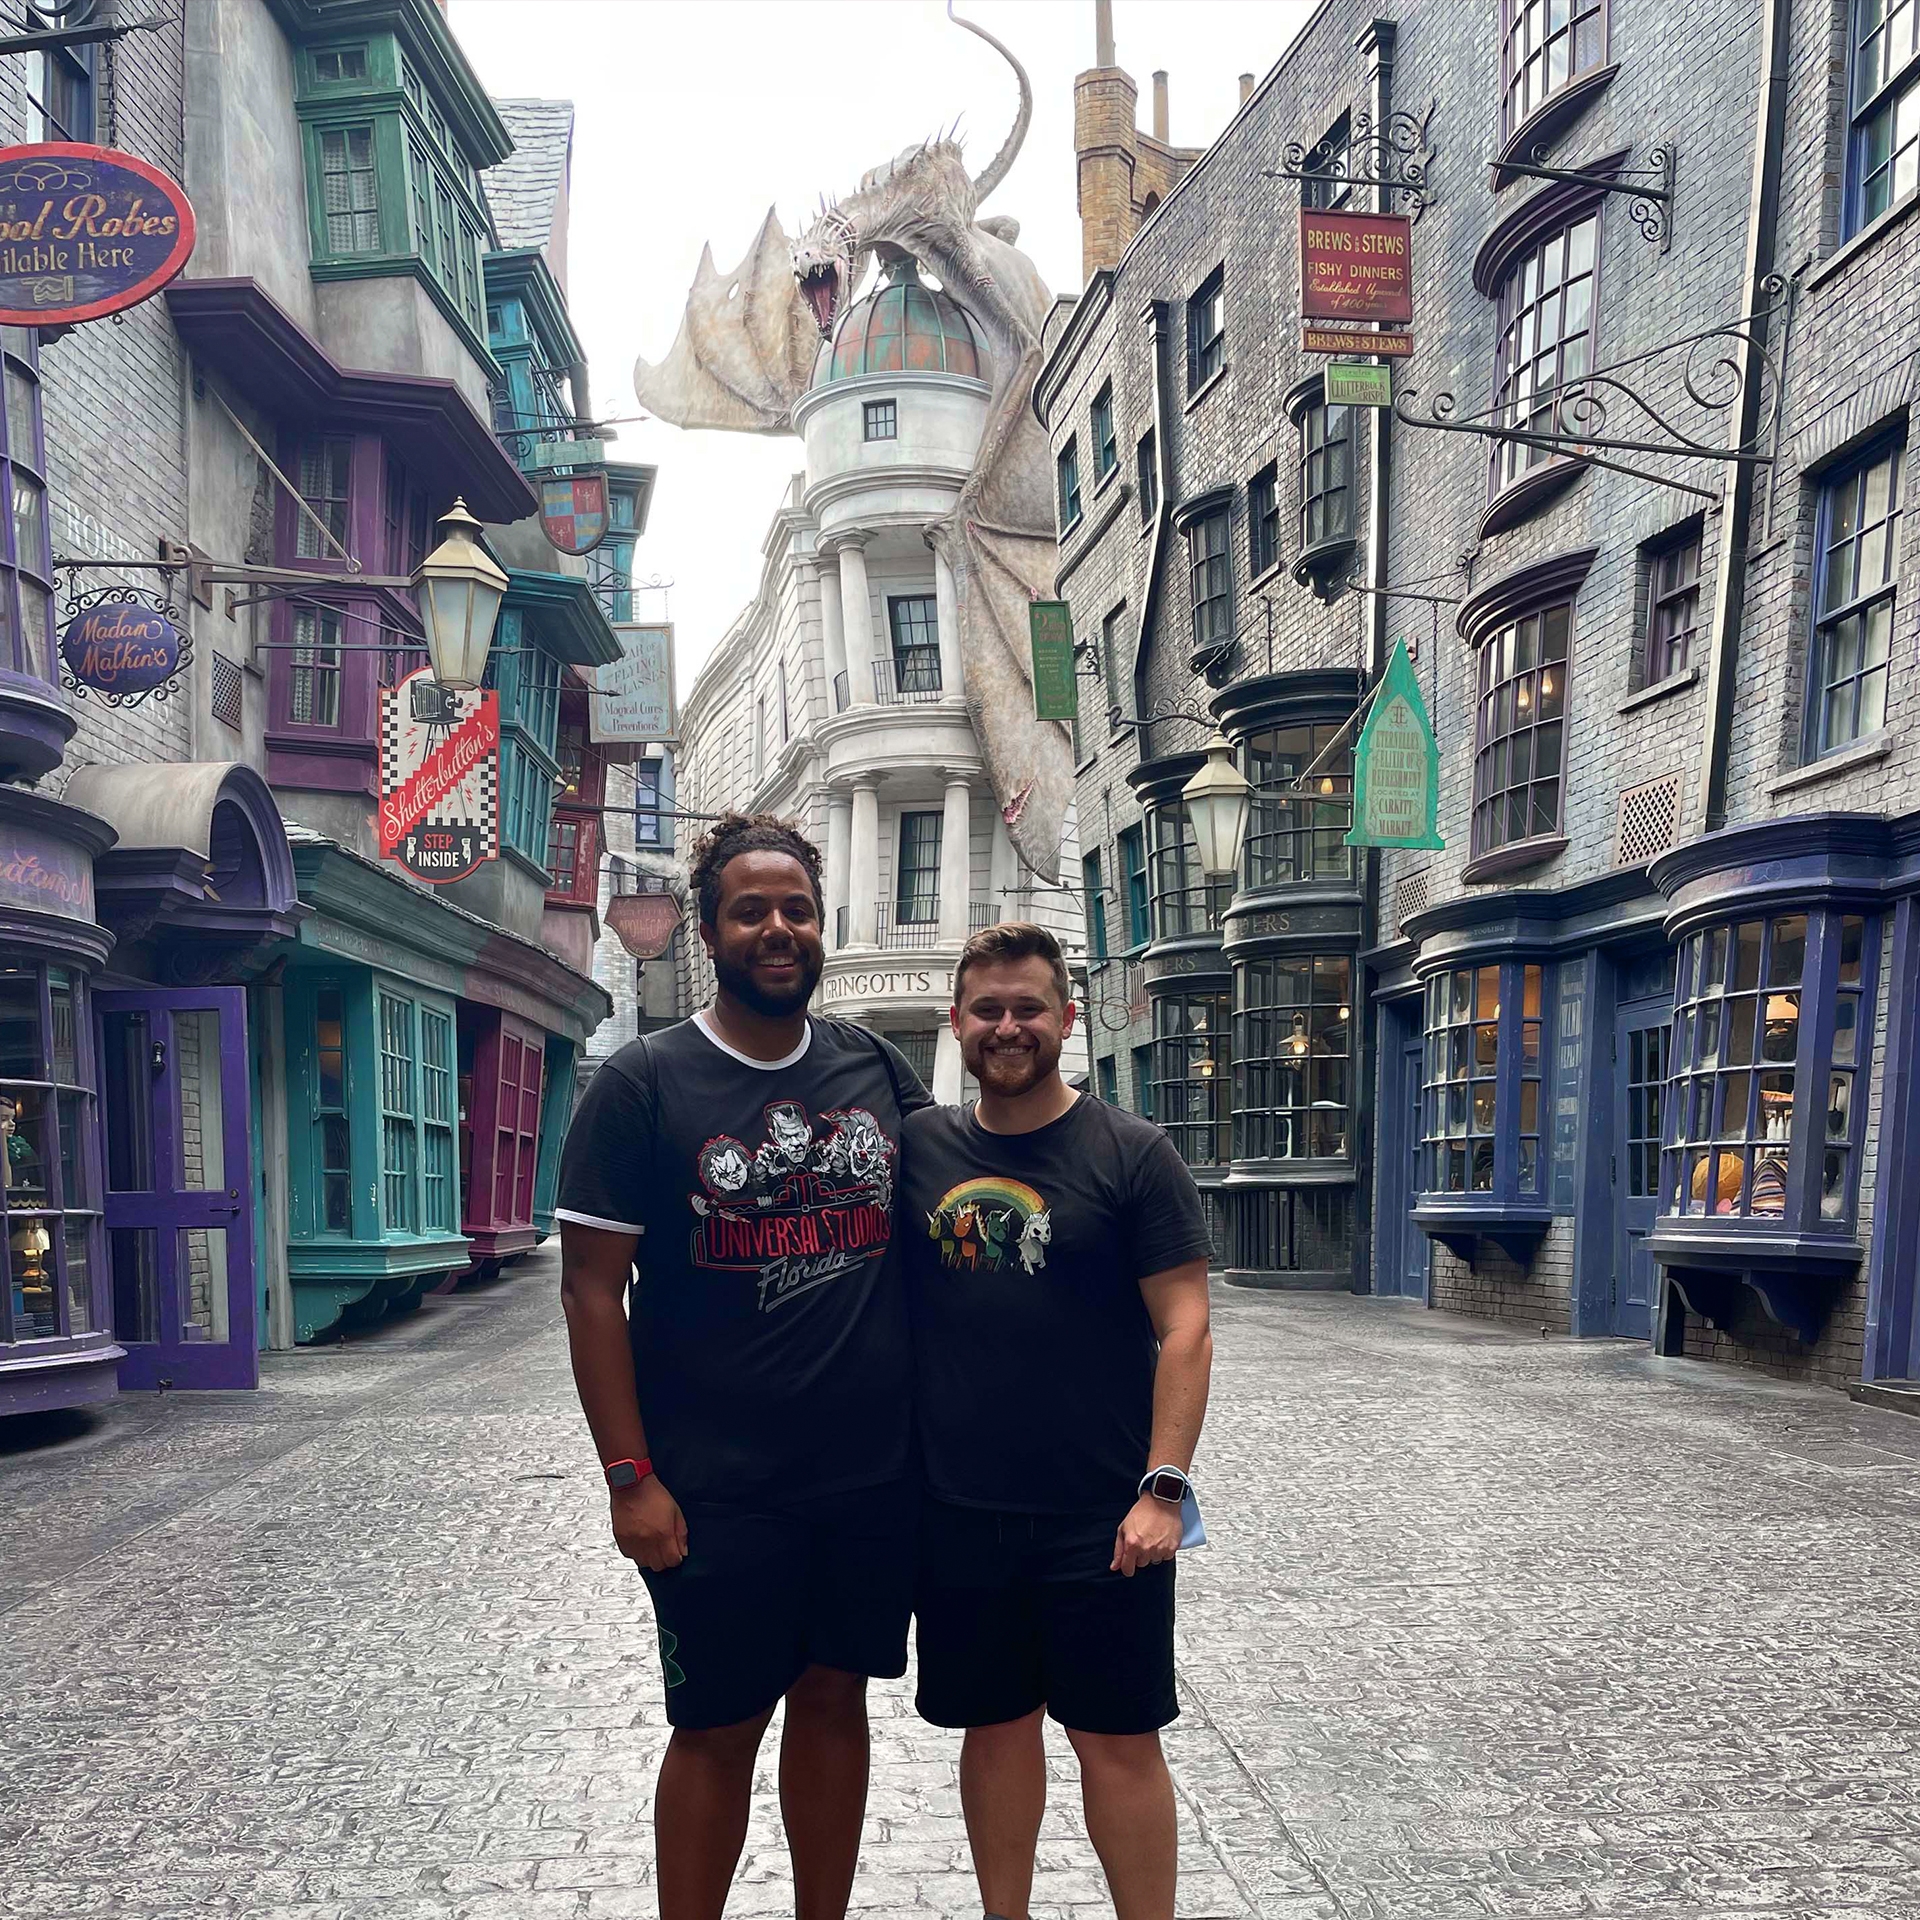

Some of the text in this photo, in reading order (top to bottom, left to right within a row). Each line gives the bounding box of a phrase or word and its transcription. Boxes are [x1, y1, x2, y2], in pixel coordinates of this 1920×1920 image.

[52, 194, 176, 240] Robes
[1308, 229, 1352, 252] BREWS
[1362, 233, 1404, 255] STEWS
[78, 242, 134, 270] Here
[1307, 261, 1404, 281] FISHY DINNERS
[1308, 278, 1361, 295] Established
[1307, 332, 1354, 348] BREWS
[1361, 336, 1407, 351] STEWS
[72, 610, 163, 646] Madam
[77, 641, 168, 682] Malkin's
[604, 700, 664, 717] Magical Cures
[612, 717, 660, 733] Preventions
[384, 721, 496, 841] Shutterbutton's
[423, 833, 454, 850] STEP
[418, 850, 460, 868] INSIDE
[825, 971, 931, 999] GRINGOTTS
[709, 1202, 891, 1259] UNIVERSAL STUDIOS
[756, 1245, 851, 1311] Florida
